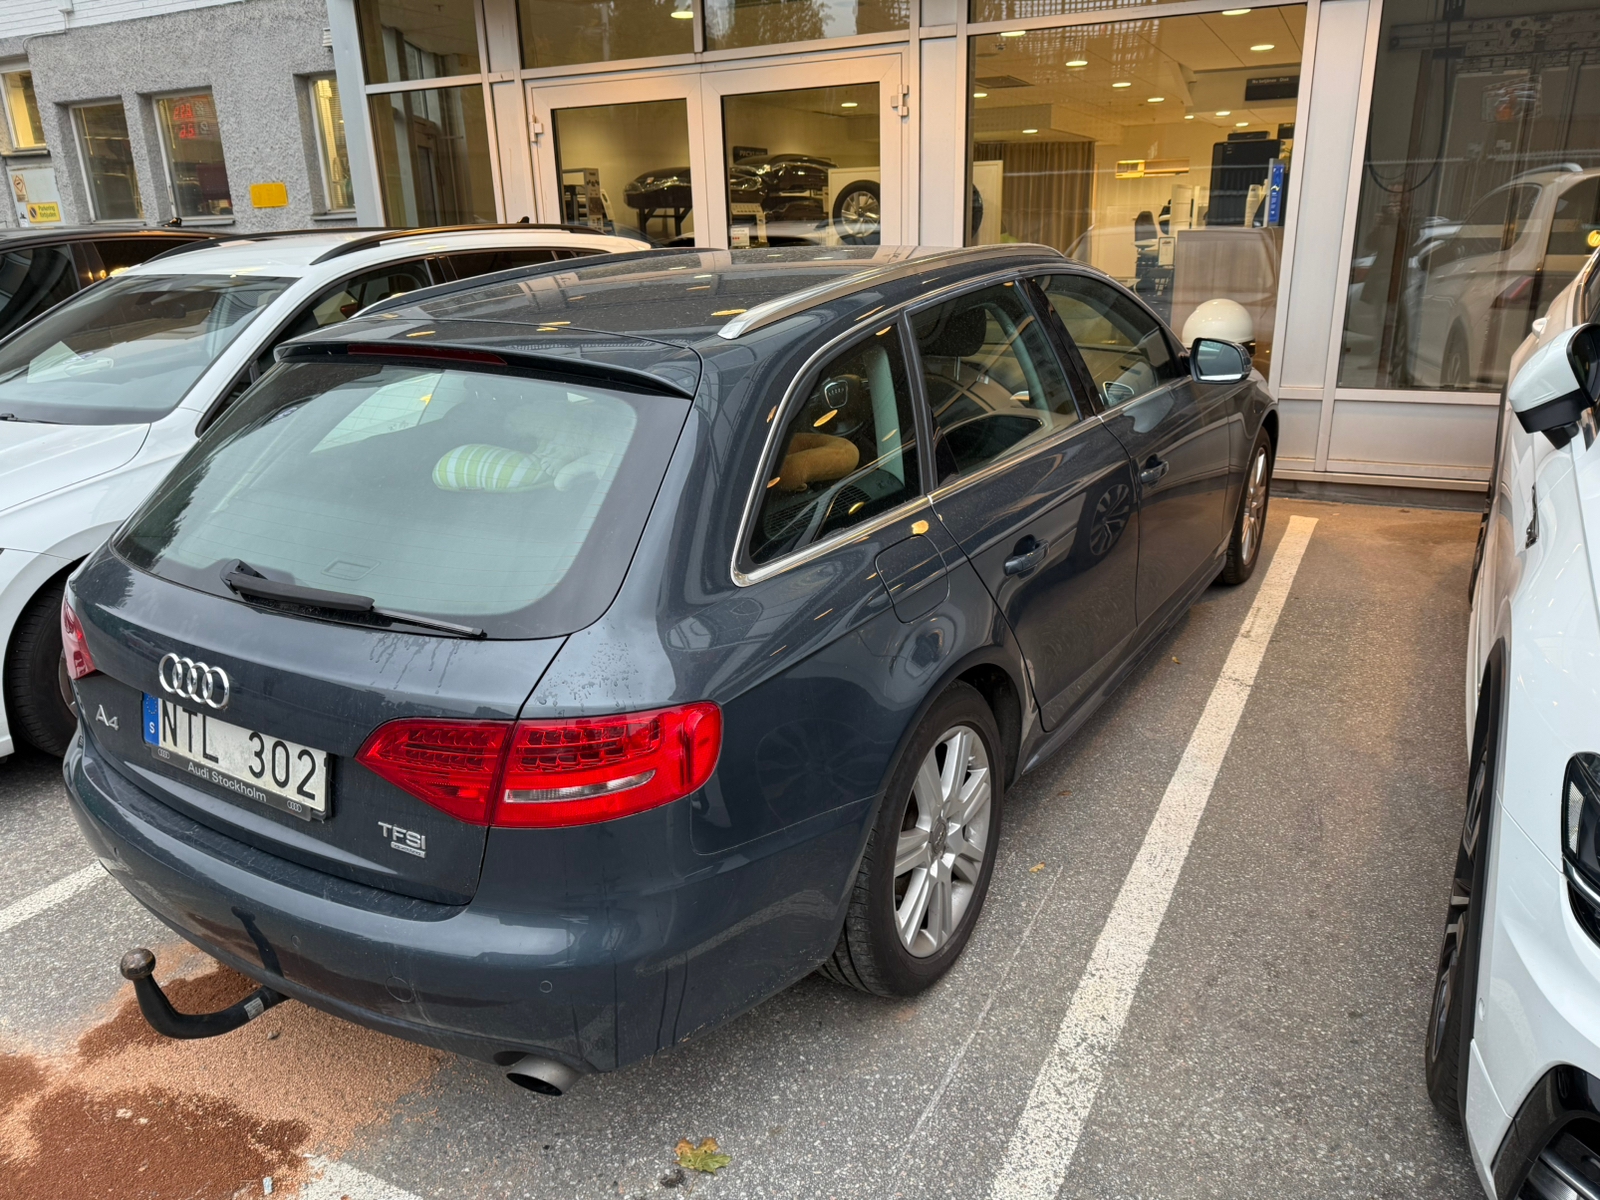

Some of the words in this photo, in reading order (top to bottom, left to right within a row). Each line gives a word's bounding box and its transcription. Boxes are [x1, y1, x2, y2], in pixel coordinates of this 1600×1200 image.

[95, 703, 119, 731] A4
[149, 721, 156, 734] S
[163, 699, 219, 764] NTL
[248, 731, 316, 801] 302
[187, 761, 209, 779] Audi
[211, 771, 267, 803] Stockholm
[377, 821, 426, 850] TFSI
